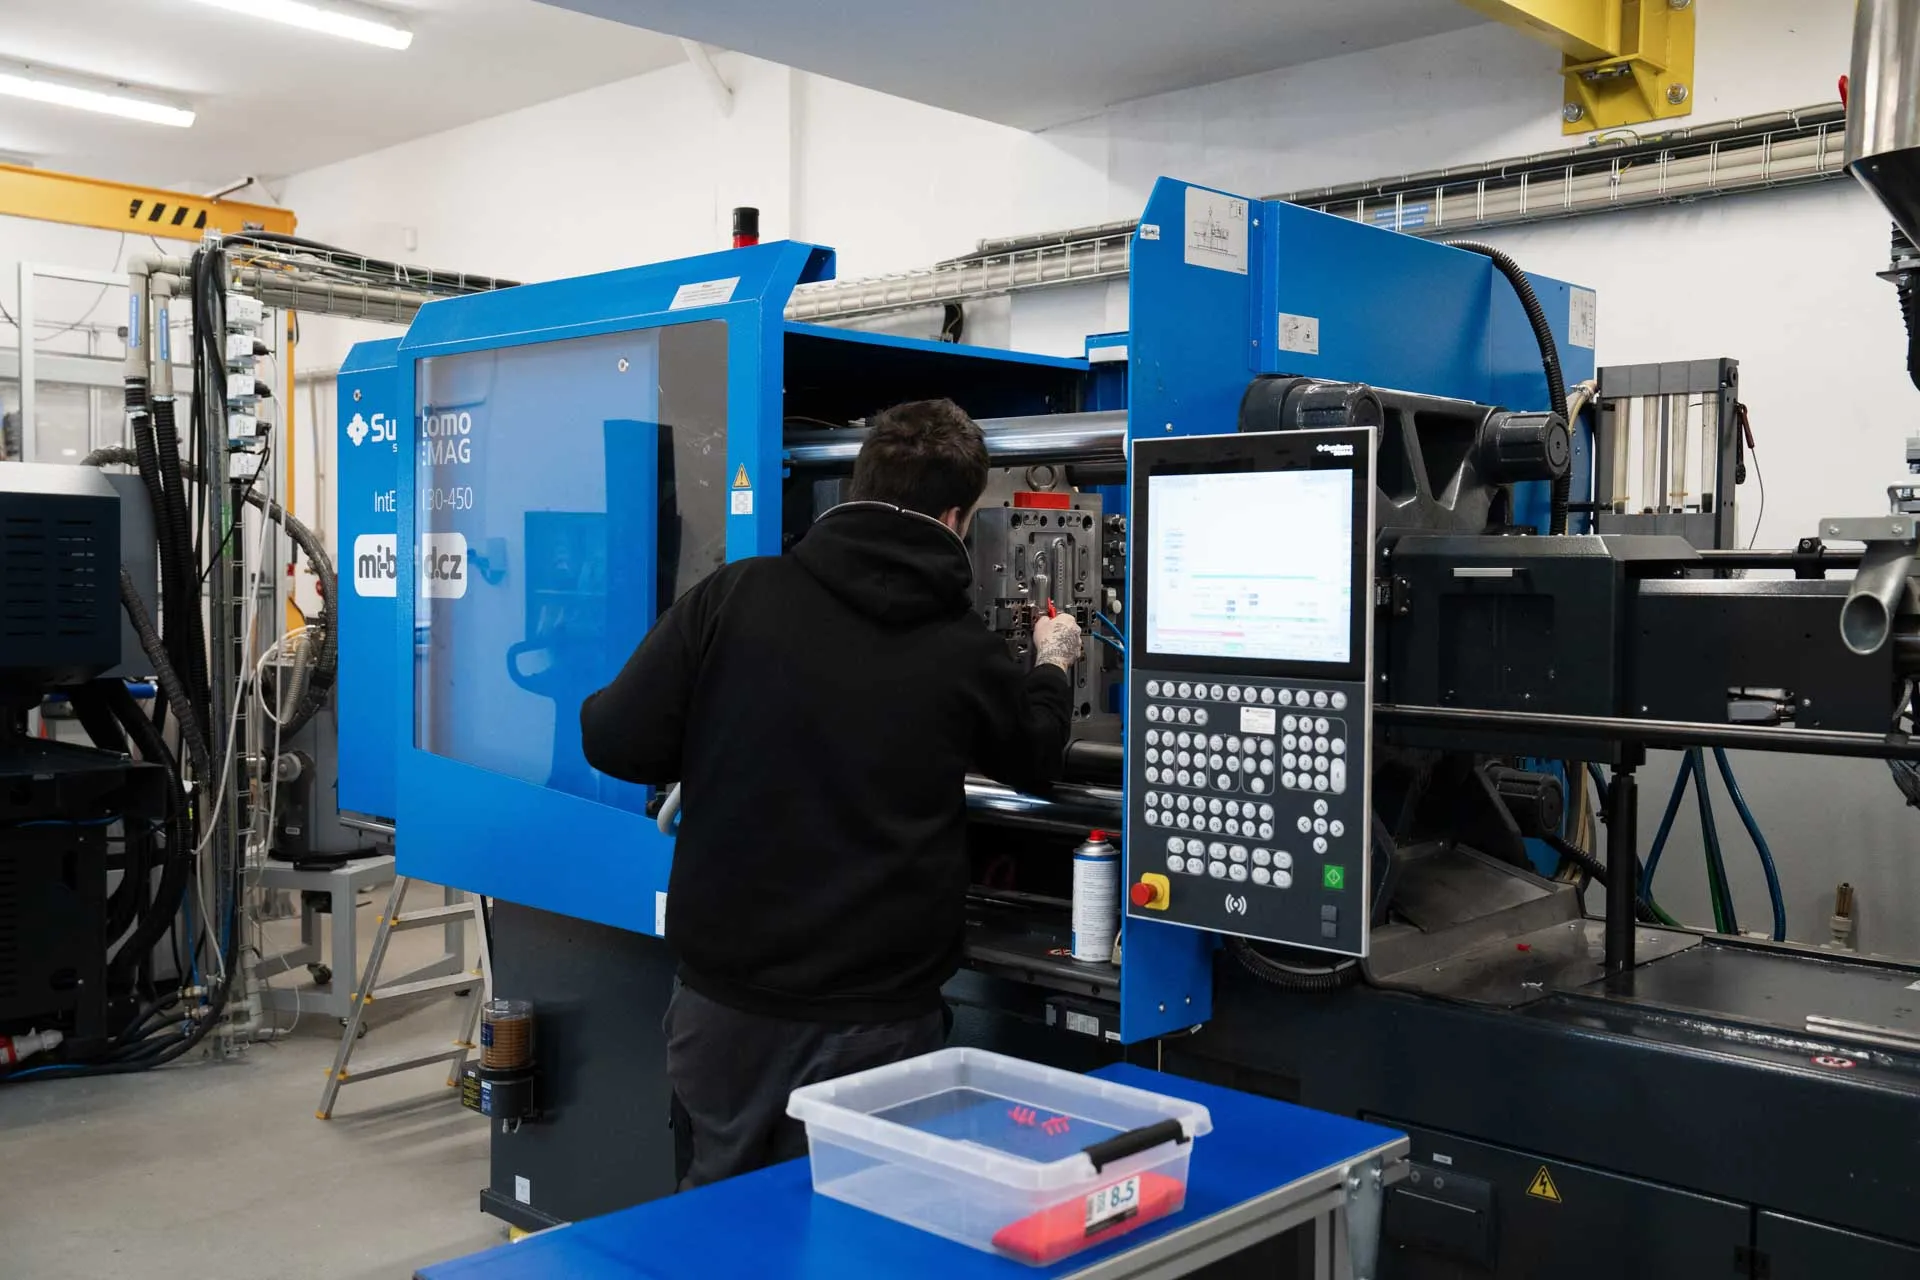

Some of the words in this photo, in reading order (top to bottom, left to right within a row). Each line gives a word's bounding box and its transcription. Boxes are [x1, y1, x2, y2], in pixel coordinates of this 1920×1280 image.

[422, 438, 471, 466] MAG
[358, 544, 462, 581] mi-bd.cz
[1110, 1180, 1134, 1208] 8.5
